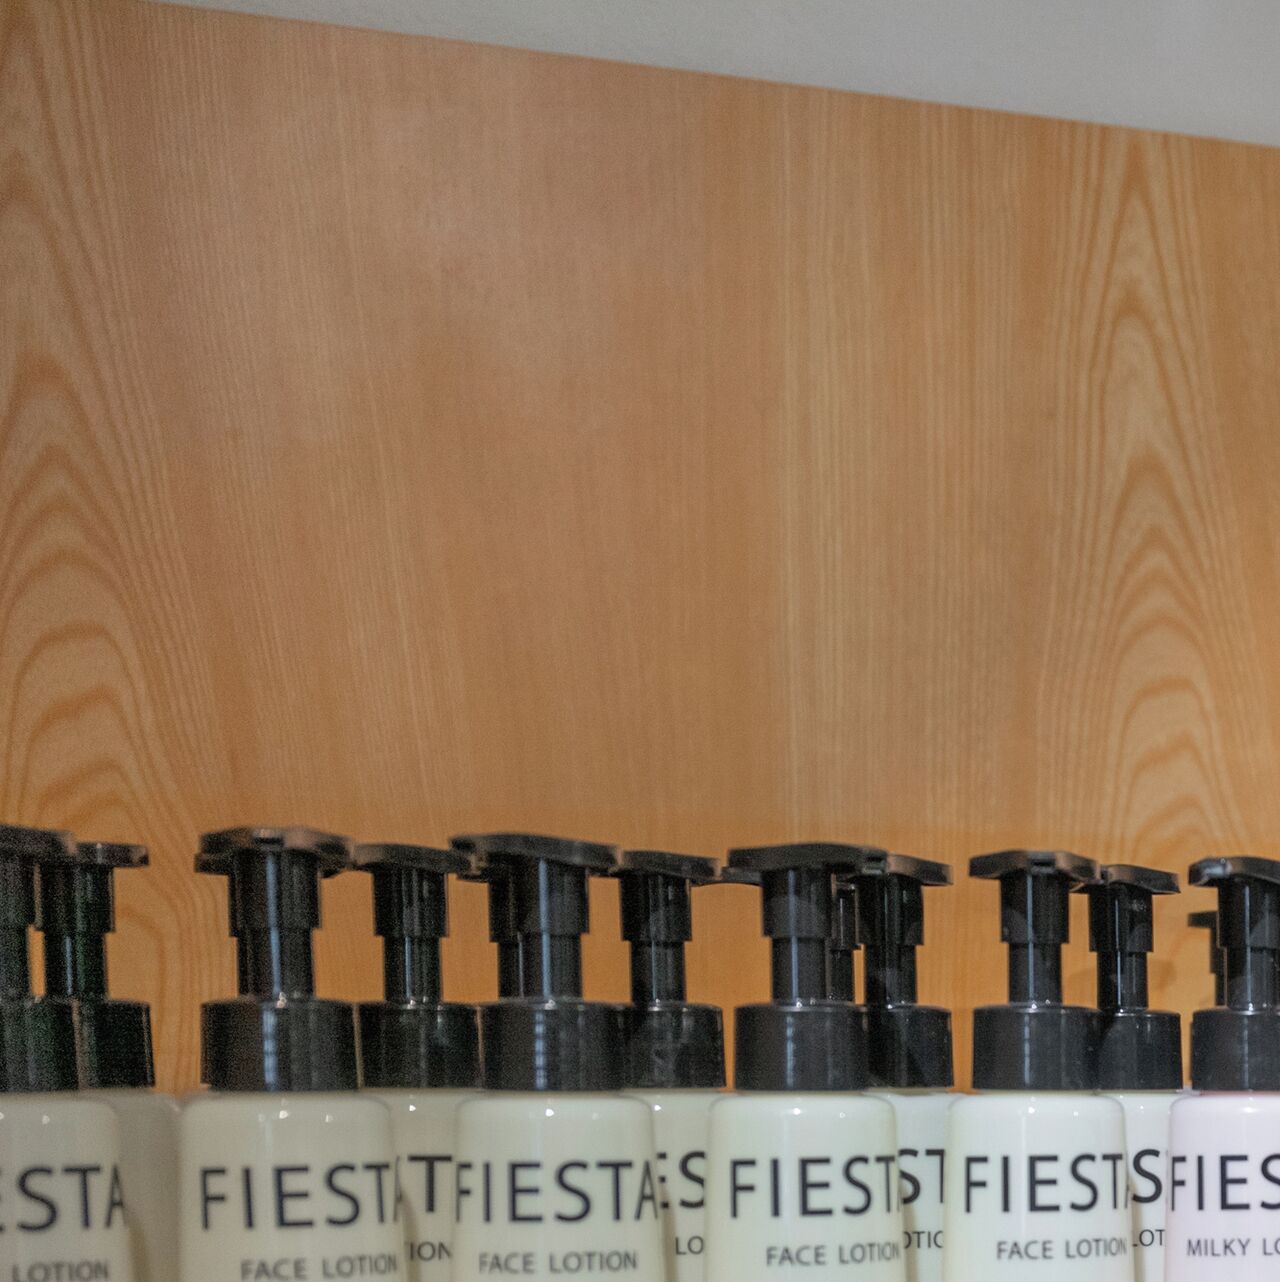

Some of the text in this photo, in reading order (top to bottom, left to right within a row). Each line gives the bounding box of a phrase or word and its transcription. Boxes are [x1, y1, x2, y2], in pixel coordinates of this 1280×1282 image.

[0, 1165, 125, 1231] STA
[456, 1160, 658, 1222] FIESTA
[730, 1155, 901, 1218] FIEST
[479, 1249, 639, 1276] FACE LOTION
[765, 1240, 900, 1268] FACE LOTION
[997, 1239, 1054, 1261] FACE
[1065, 1236, 1128, 1260] LOTION
[1187, 1237, 1251, 1260] MILKY
[240, 1251, 398, 1282] FACE LOTION
